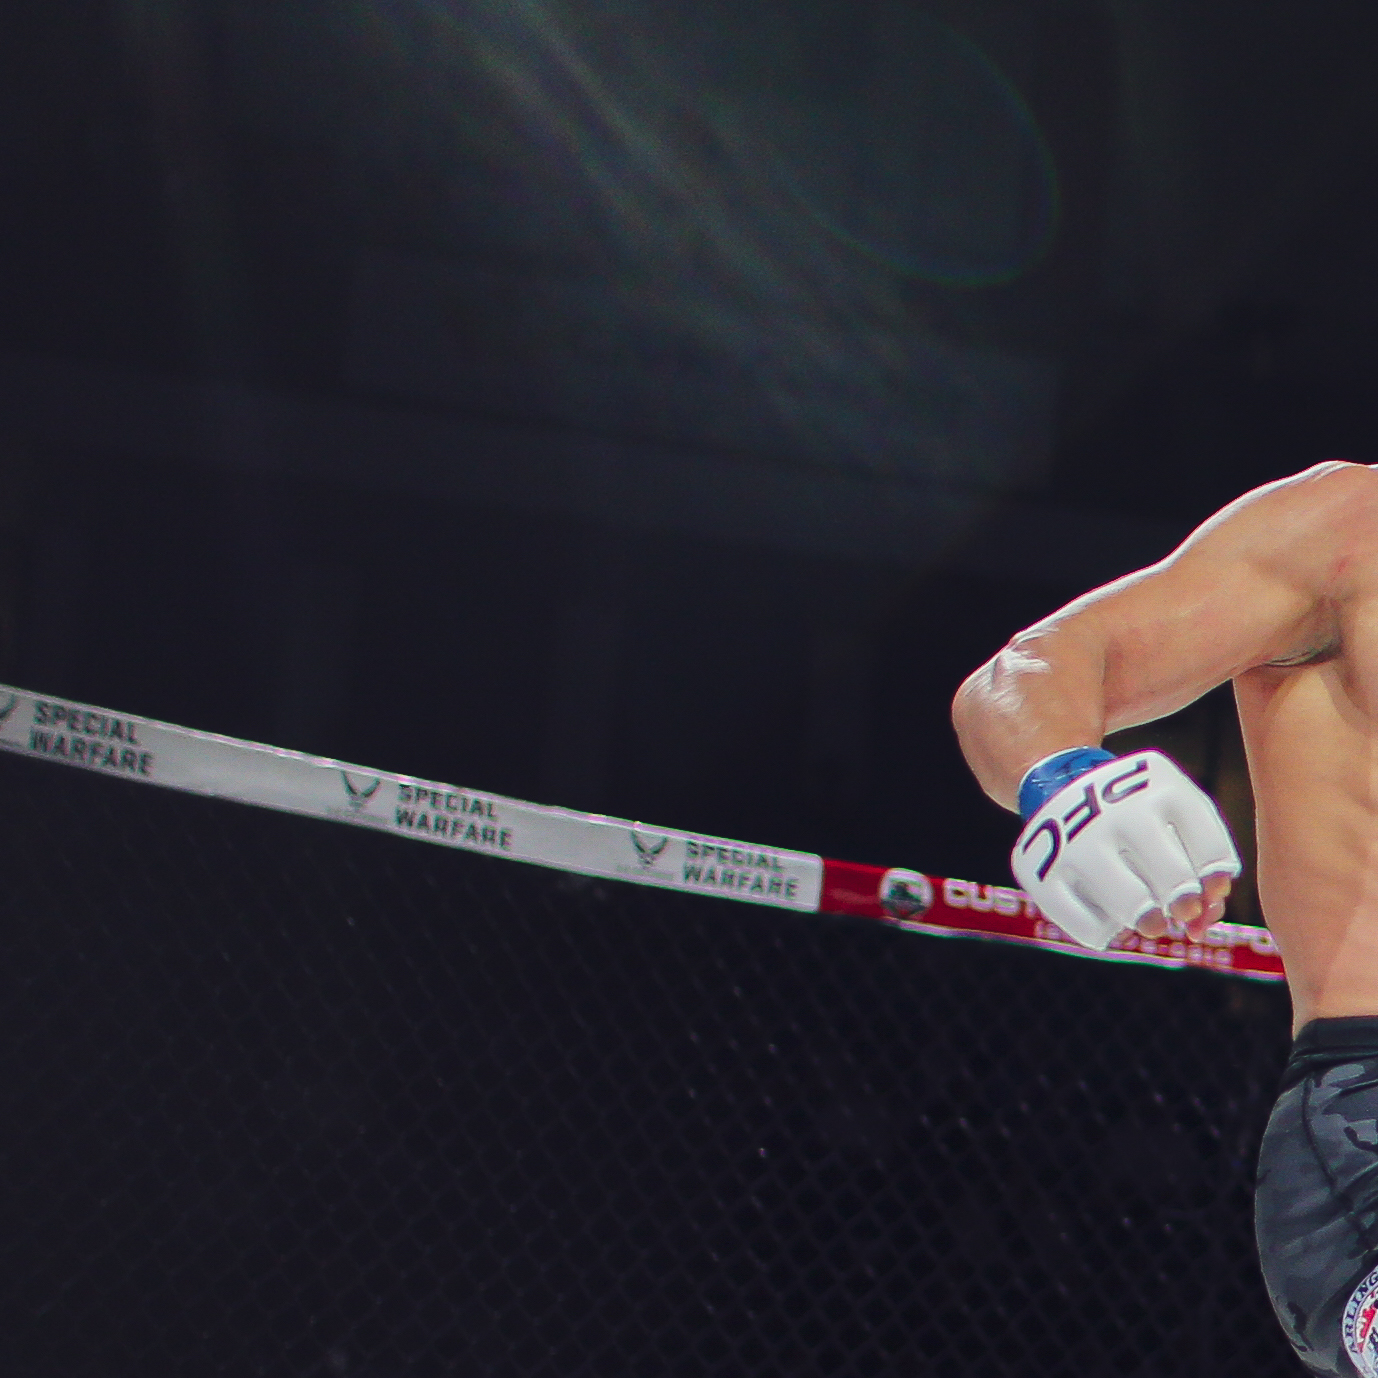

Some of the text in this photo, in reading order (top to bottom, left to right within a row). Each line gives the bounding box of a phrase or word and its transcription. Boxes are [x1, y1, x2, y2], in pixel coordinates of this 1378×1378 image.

[34, 700, 139, 745] SPECIAL
[27, 728, 154, 776] WARFARE
[397, 783, 499, 819] SPECIAL
[1022, 758, 1151, 883] PFC
[394, 809, 514, 851] WARFARE
[685, 840, 784, 873] SPECIAL
[682, 864, 799, 900] WARFARE
